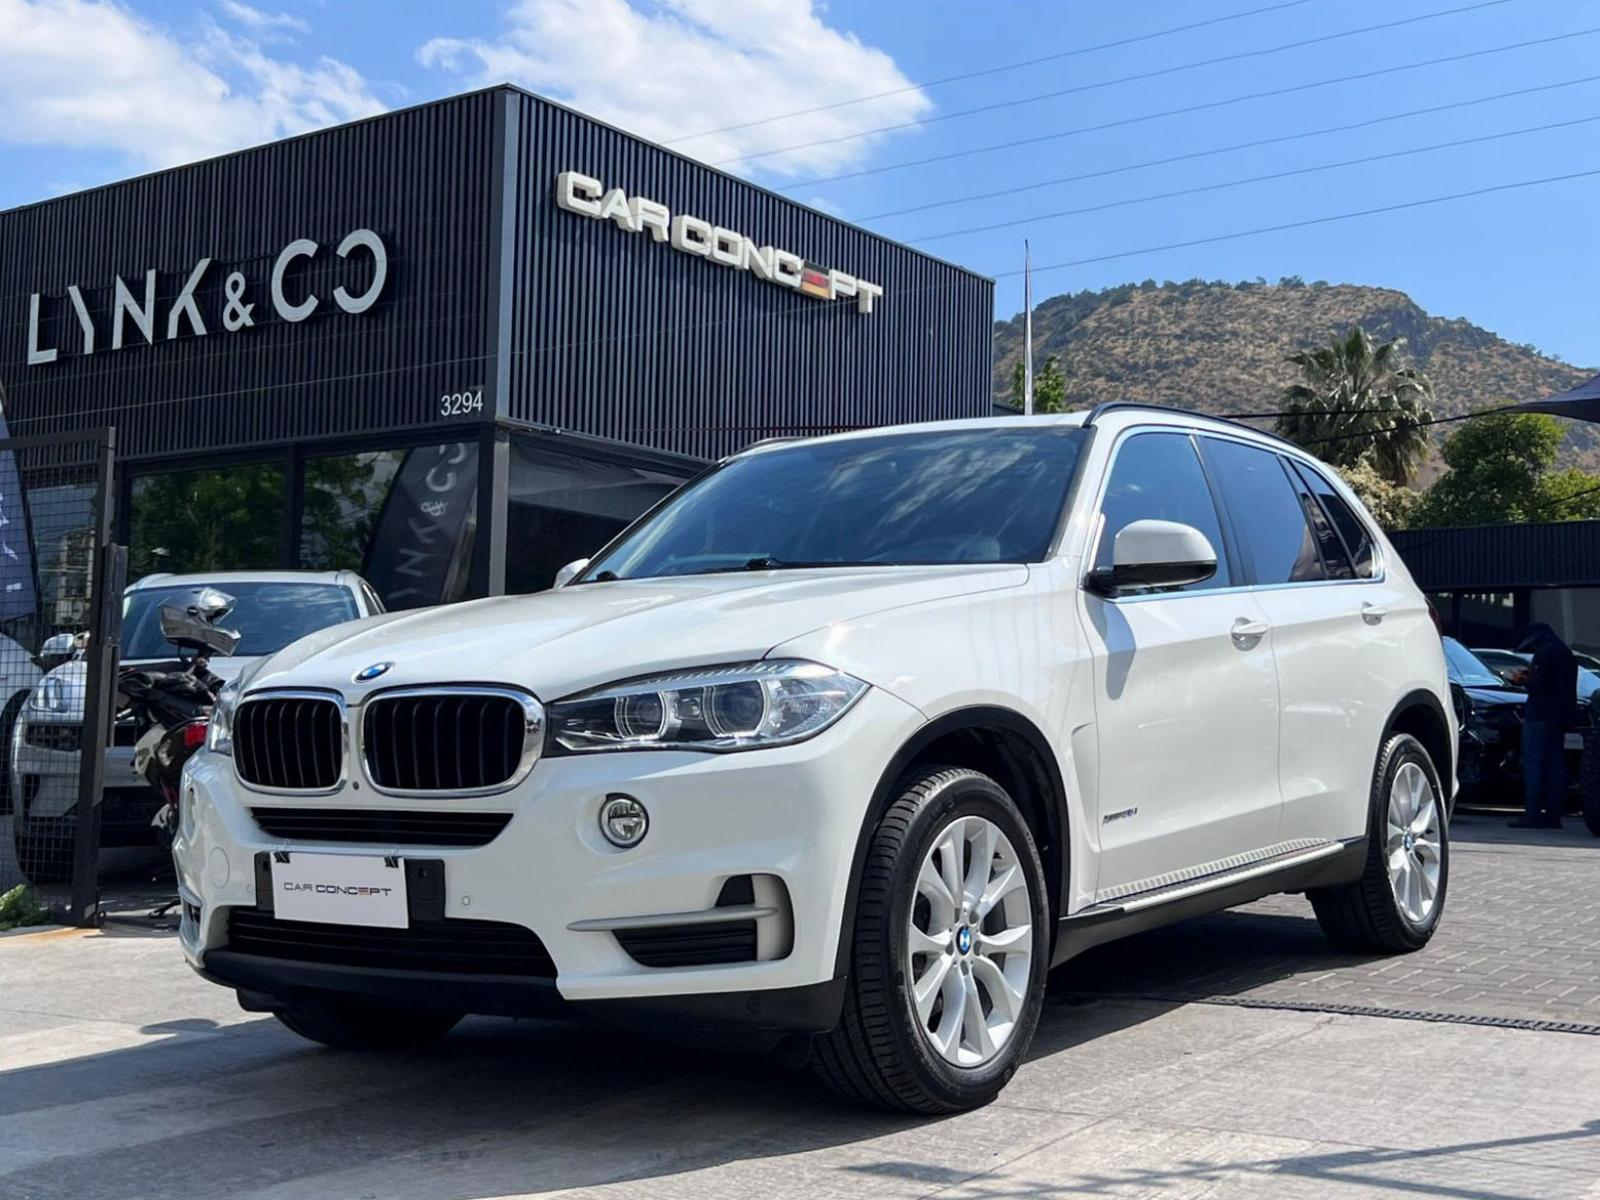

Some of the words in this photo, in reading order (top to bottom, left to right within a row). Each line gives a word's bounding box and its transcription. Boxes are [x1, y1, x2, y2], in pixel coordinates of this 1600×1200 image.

[557, 170, 670, 243] CAR
[671, 214, 883, 314] CONCEPT
[440, 390, 484, 417] 3294
[283, 881, 313, 892] CAR
[315, 884, 392, 897] CONCEPT
